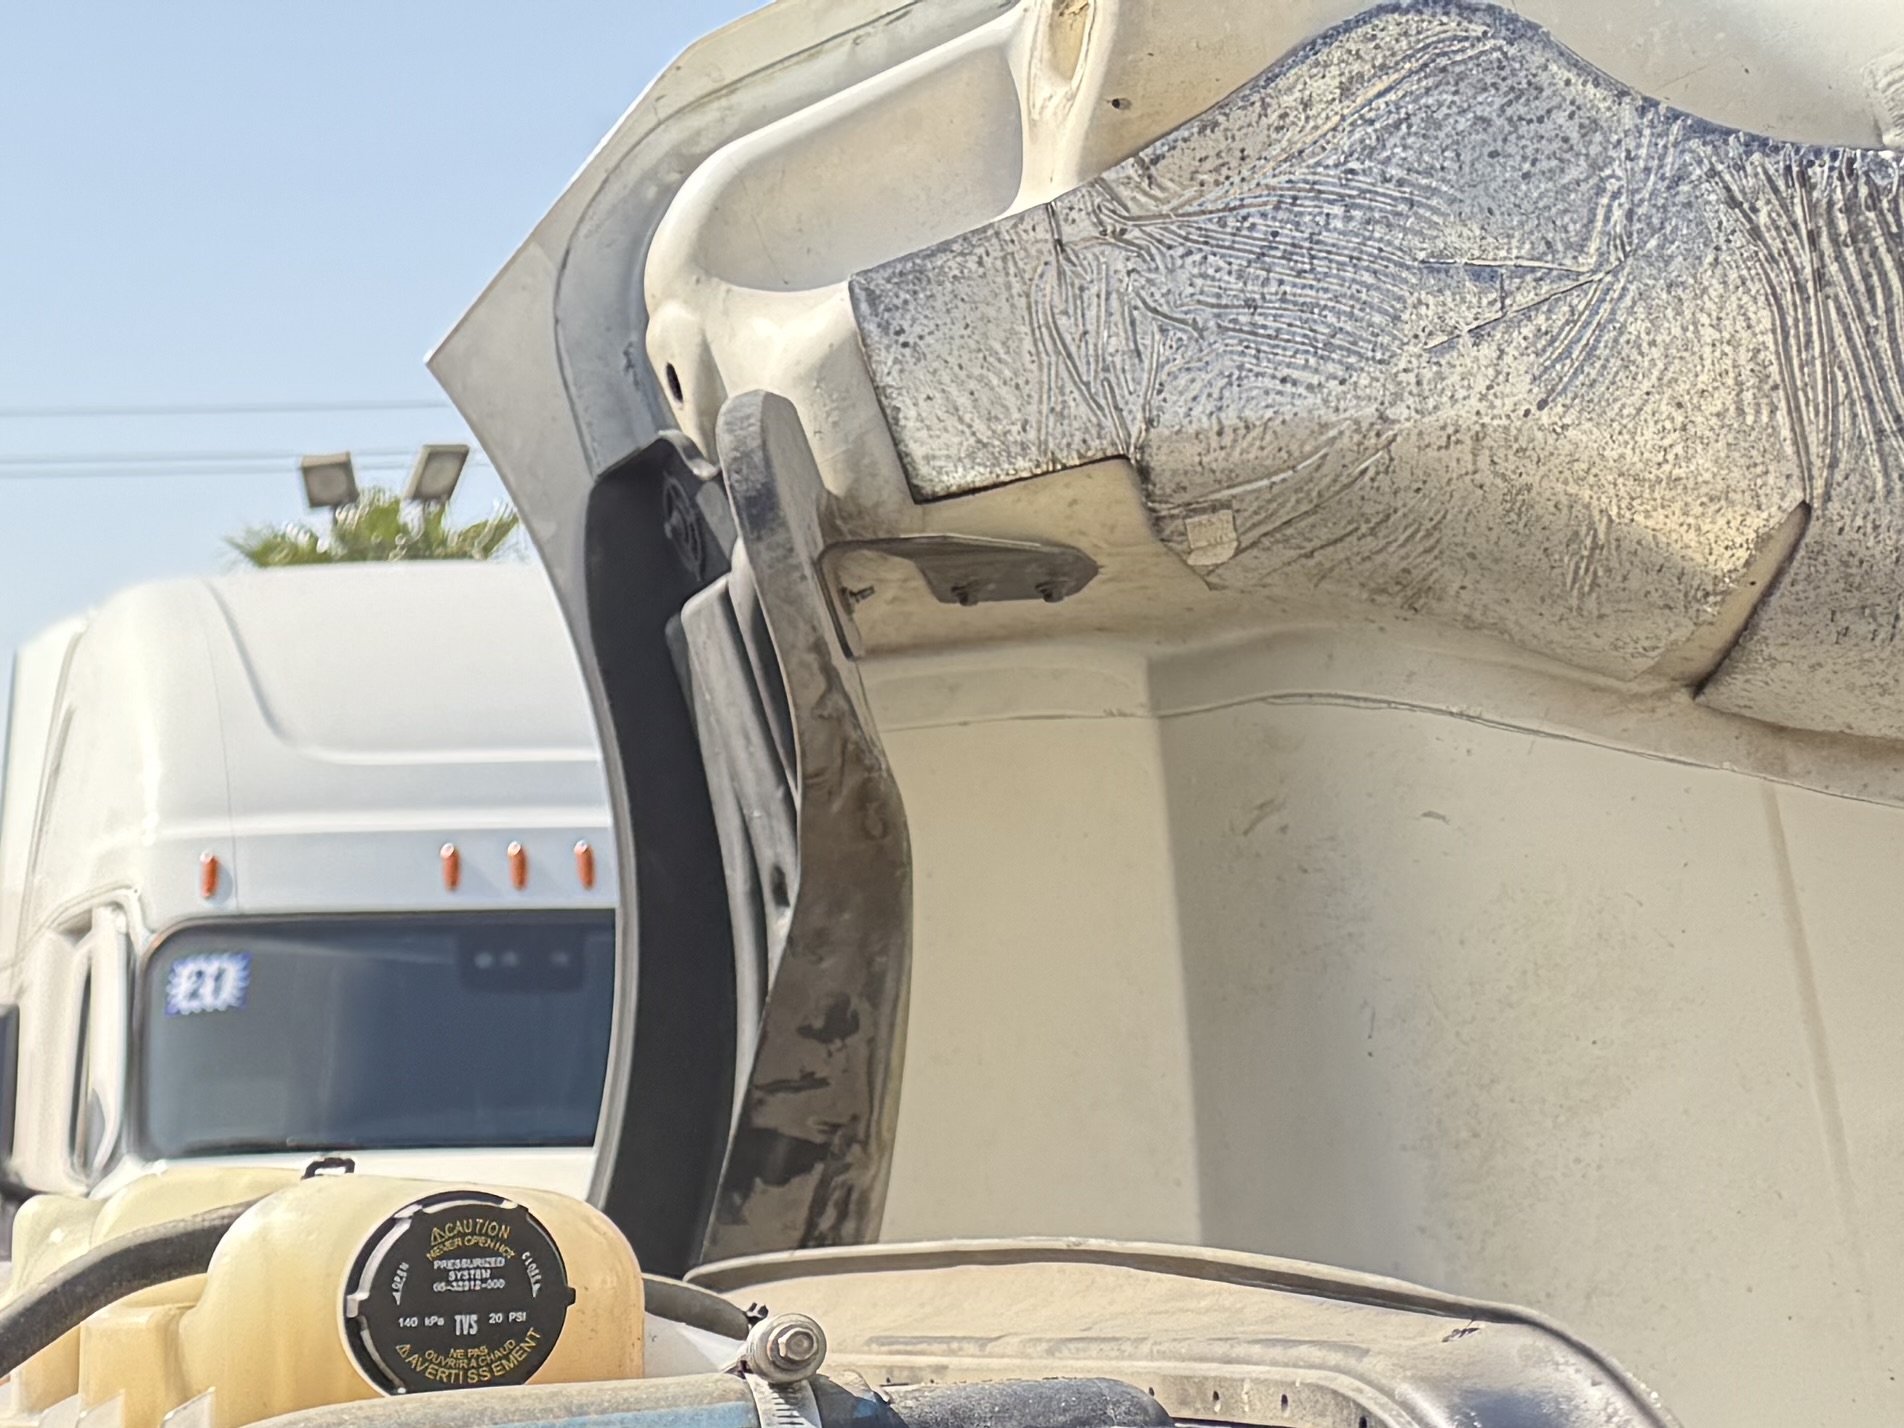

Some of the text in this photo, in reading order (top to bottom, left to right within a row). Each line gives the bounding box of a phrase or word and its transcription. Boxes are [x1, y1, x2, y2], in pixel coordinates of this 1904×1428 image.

[444, 1218, 511, 1240] CAUTION
[433, 1256, 506, 1270] PRESSURIZED
[448, 1269, 492, 1281] SYSTEM
[398, 1315, 445, 1328] 140 kPa
[488, 1312, 527, 1324] 20 PSI
[454, 1314, 478, 1336] TVS
[424, 1349, 468, 1369] OUVRIR
[478, 1339, 517, 1367] CHAUD
[448, 1345, 489, 1358] NE PAS
